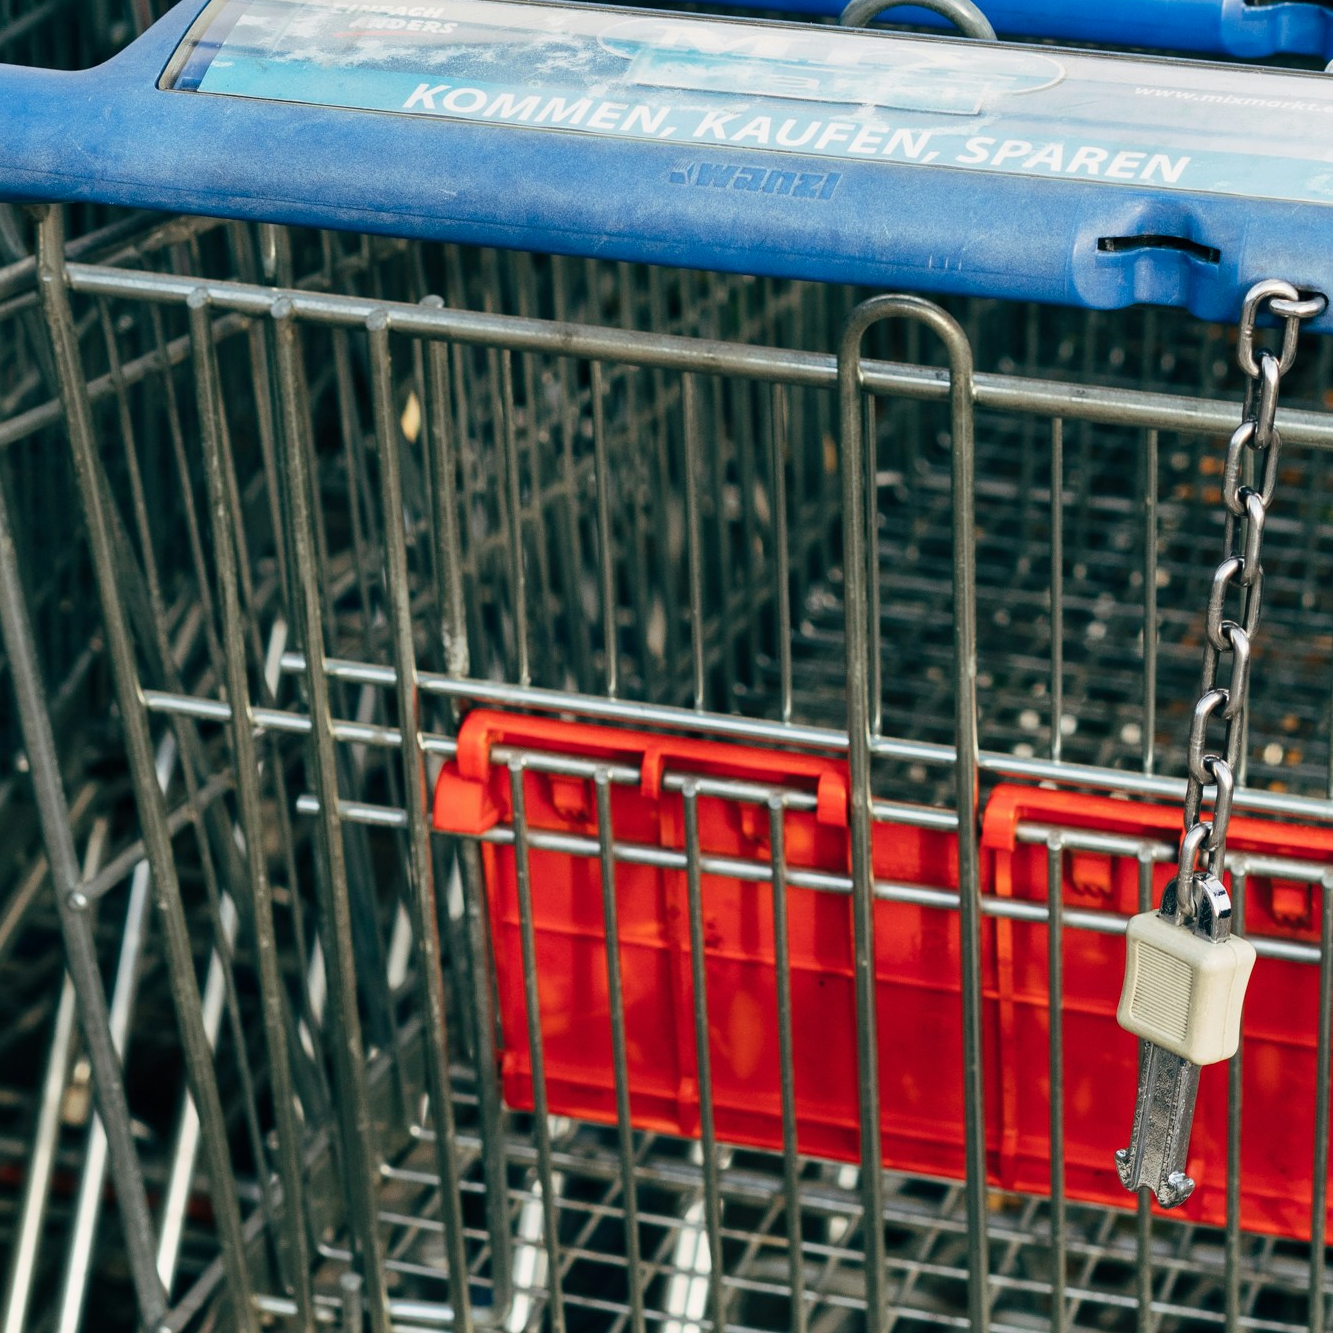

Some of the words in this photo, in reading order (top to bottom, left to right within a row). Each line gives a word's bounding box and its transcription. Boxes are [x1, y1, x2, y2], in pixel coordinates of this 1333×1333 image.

[402, 82, 677, 138] KOMMEN,
[692, 108, 941, 164] KAUFEN,
[955, 136, 1191, 184] SPAREN
